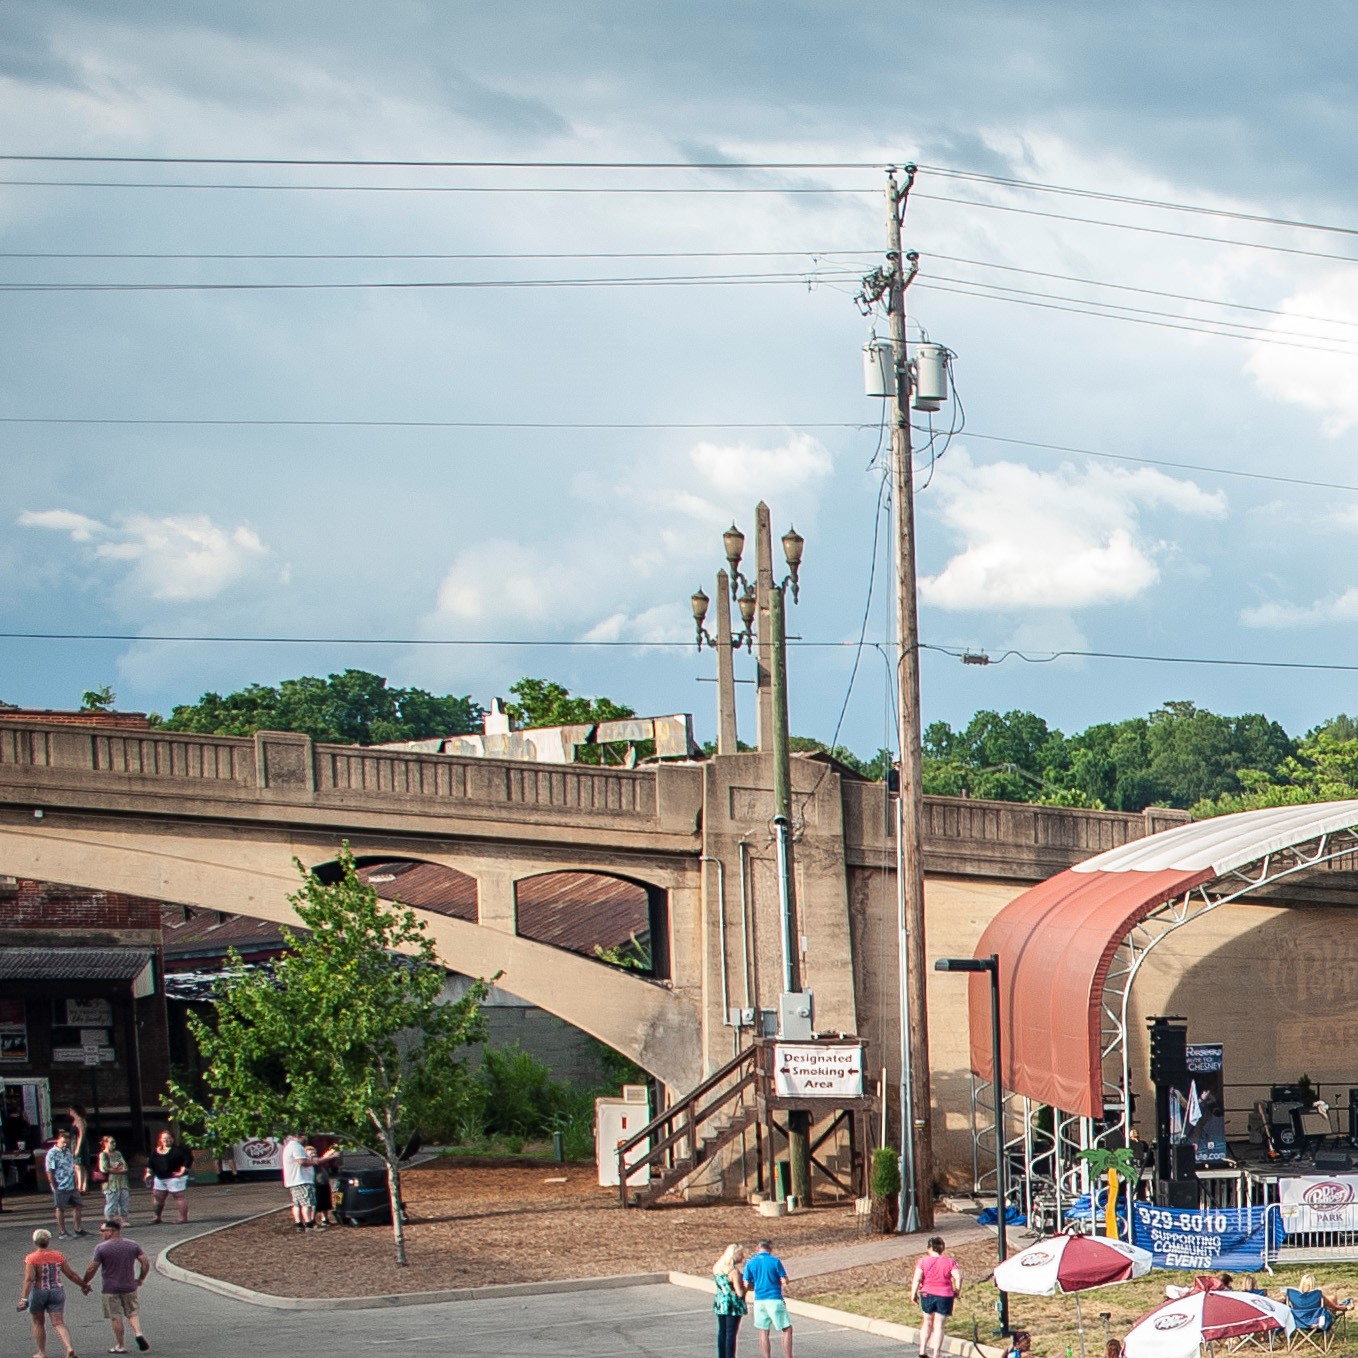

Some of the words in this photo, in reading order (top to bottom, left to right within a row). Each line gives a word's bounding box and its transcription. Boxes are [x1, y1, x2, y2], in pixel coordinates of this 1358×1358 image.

[784, 1053, 853, 1065] Designated
[793, 1067, 845, 1079] Smoking
[1188, 1063, 1222, 1072] CHESNEY
[804, 1080, 833, 1088] Area
[1323, 1185, 1337, 1197] Dr
[1138, 1207, 1227, 1233] 929-8010
[1316, 1213, 1344, 1223] PARK
[1150, 1229, 1222, 1246] SUPPORTING
[1153, 1240, 1221, 1257] COMMUNITY
[1165, 1253, 1212, 1269] EVENTS
